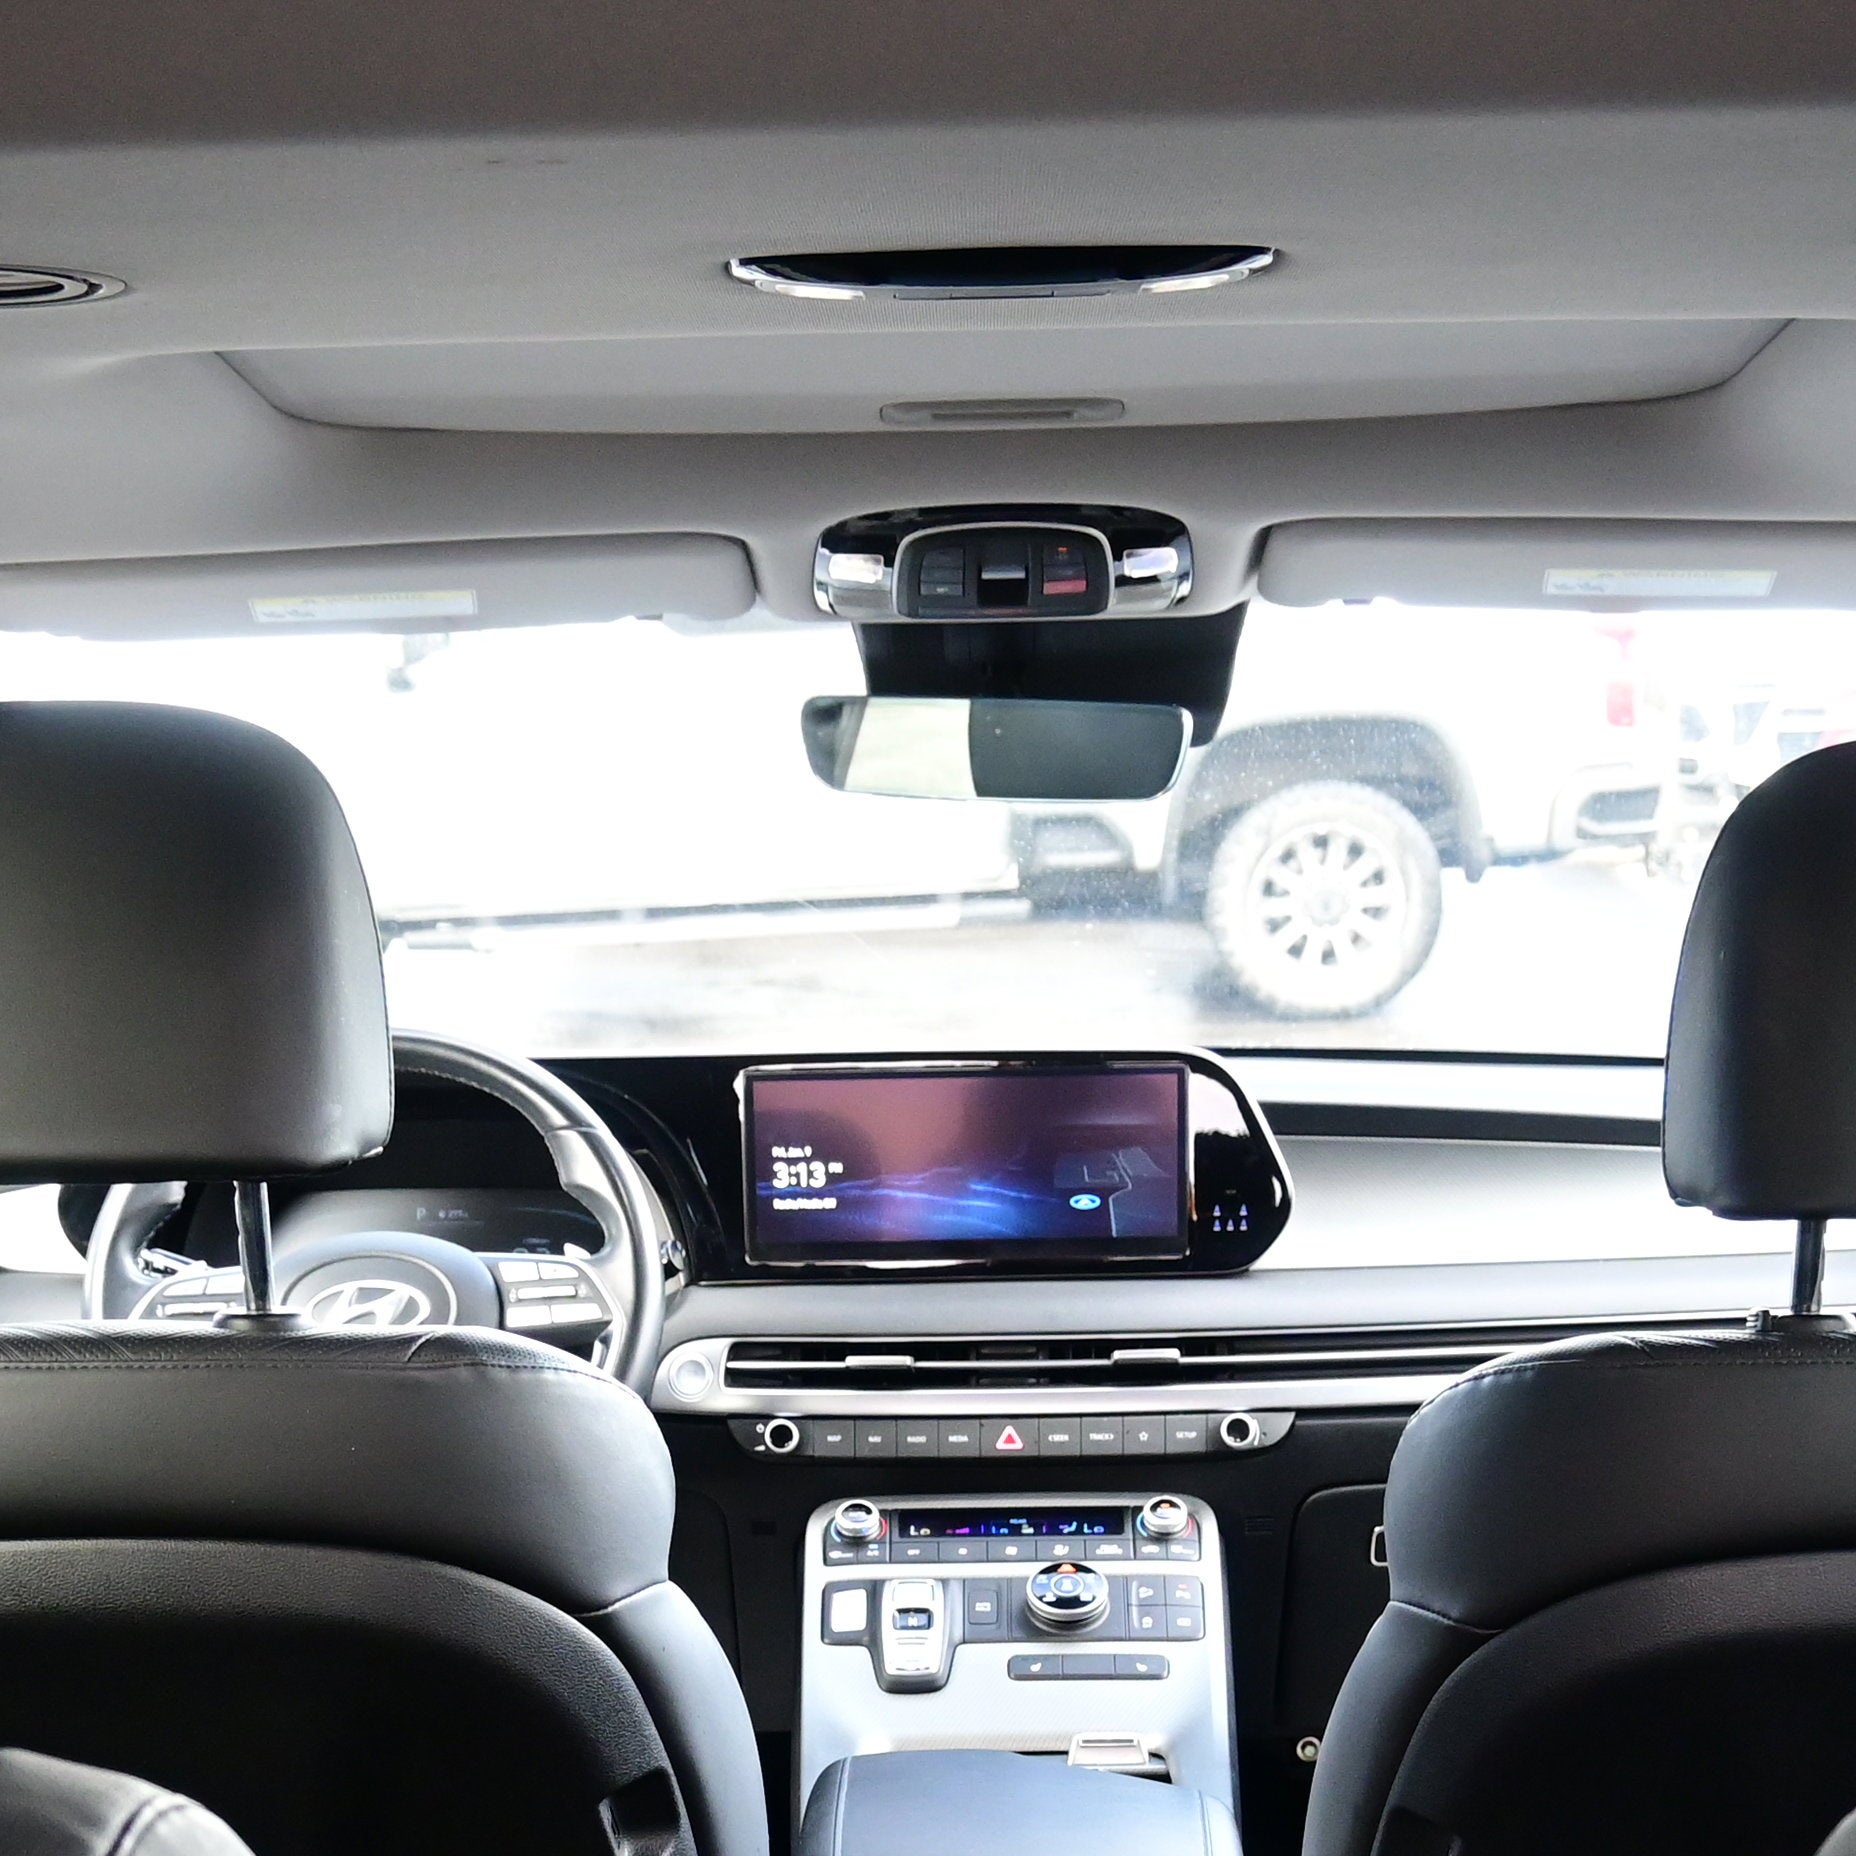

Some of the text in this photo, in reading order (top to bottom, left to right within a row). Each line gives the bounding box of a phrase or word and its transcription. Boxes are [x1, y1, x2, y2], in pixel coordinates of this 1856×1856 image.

[772, 1161, 827, 1189] 3:13
[948, 1434, 969, 1443] MEDIA
[1176, 1430, 1197, 1439] SETUP
